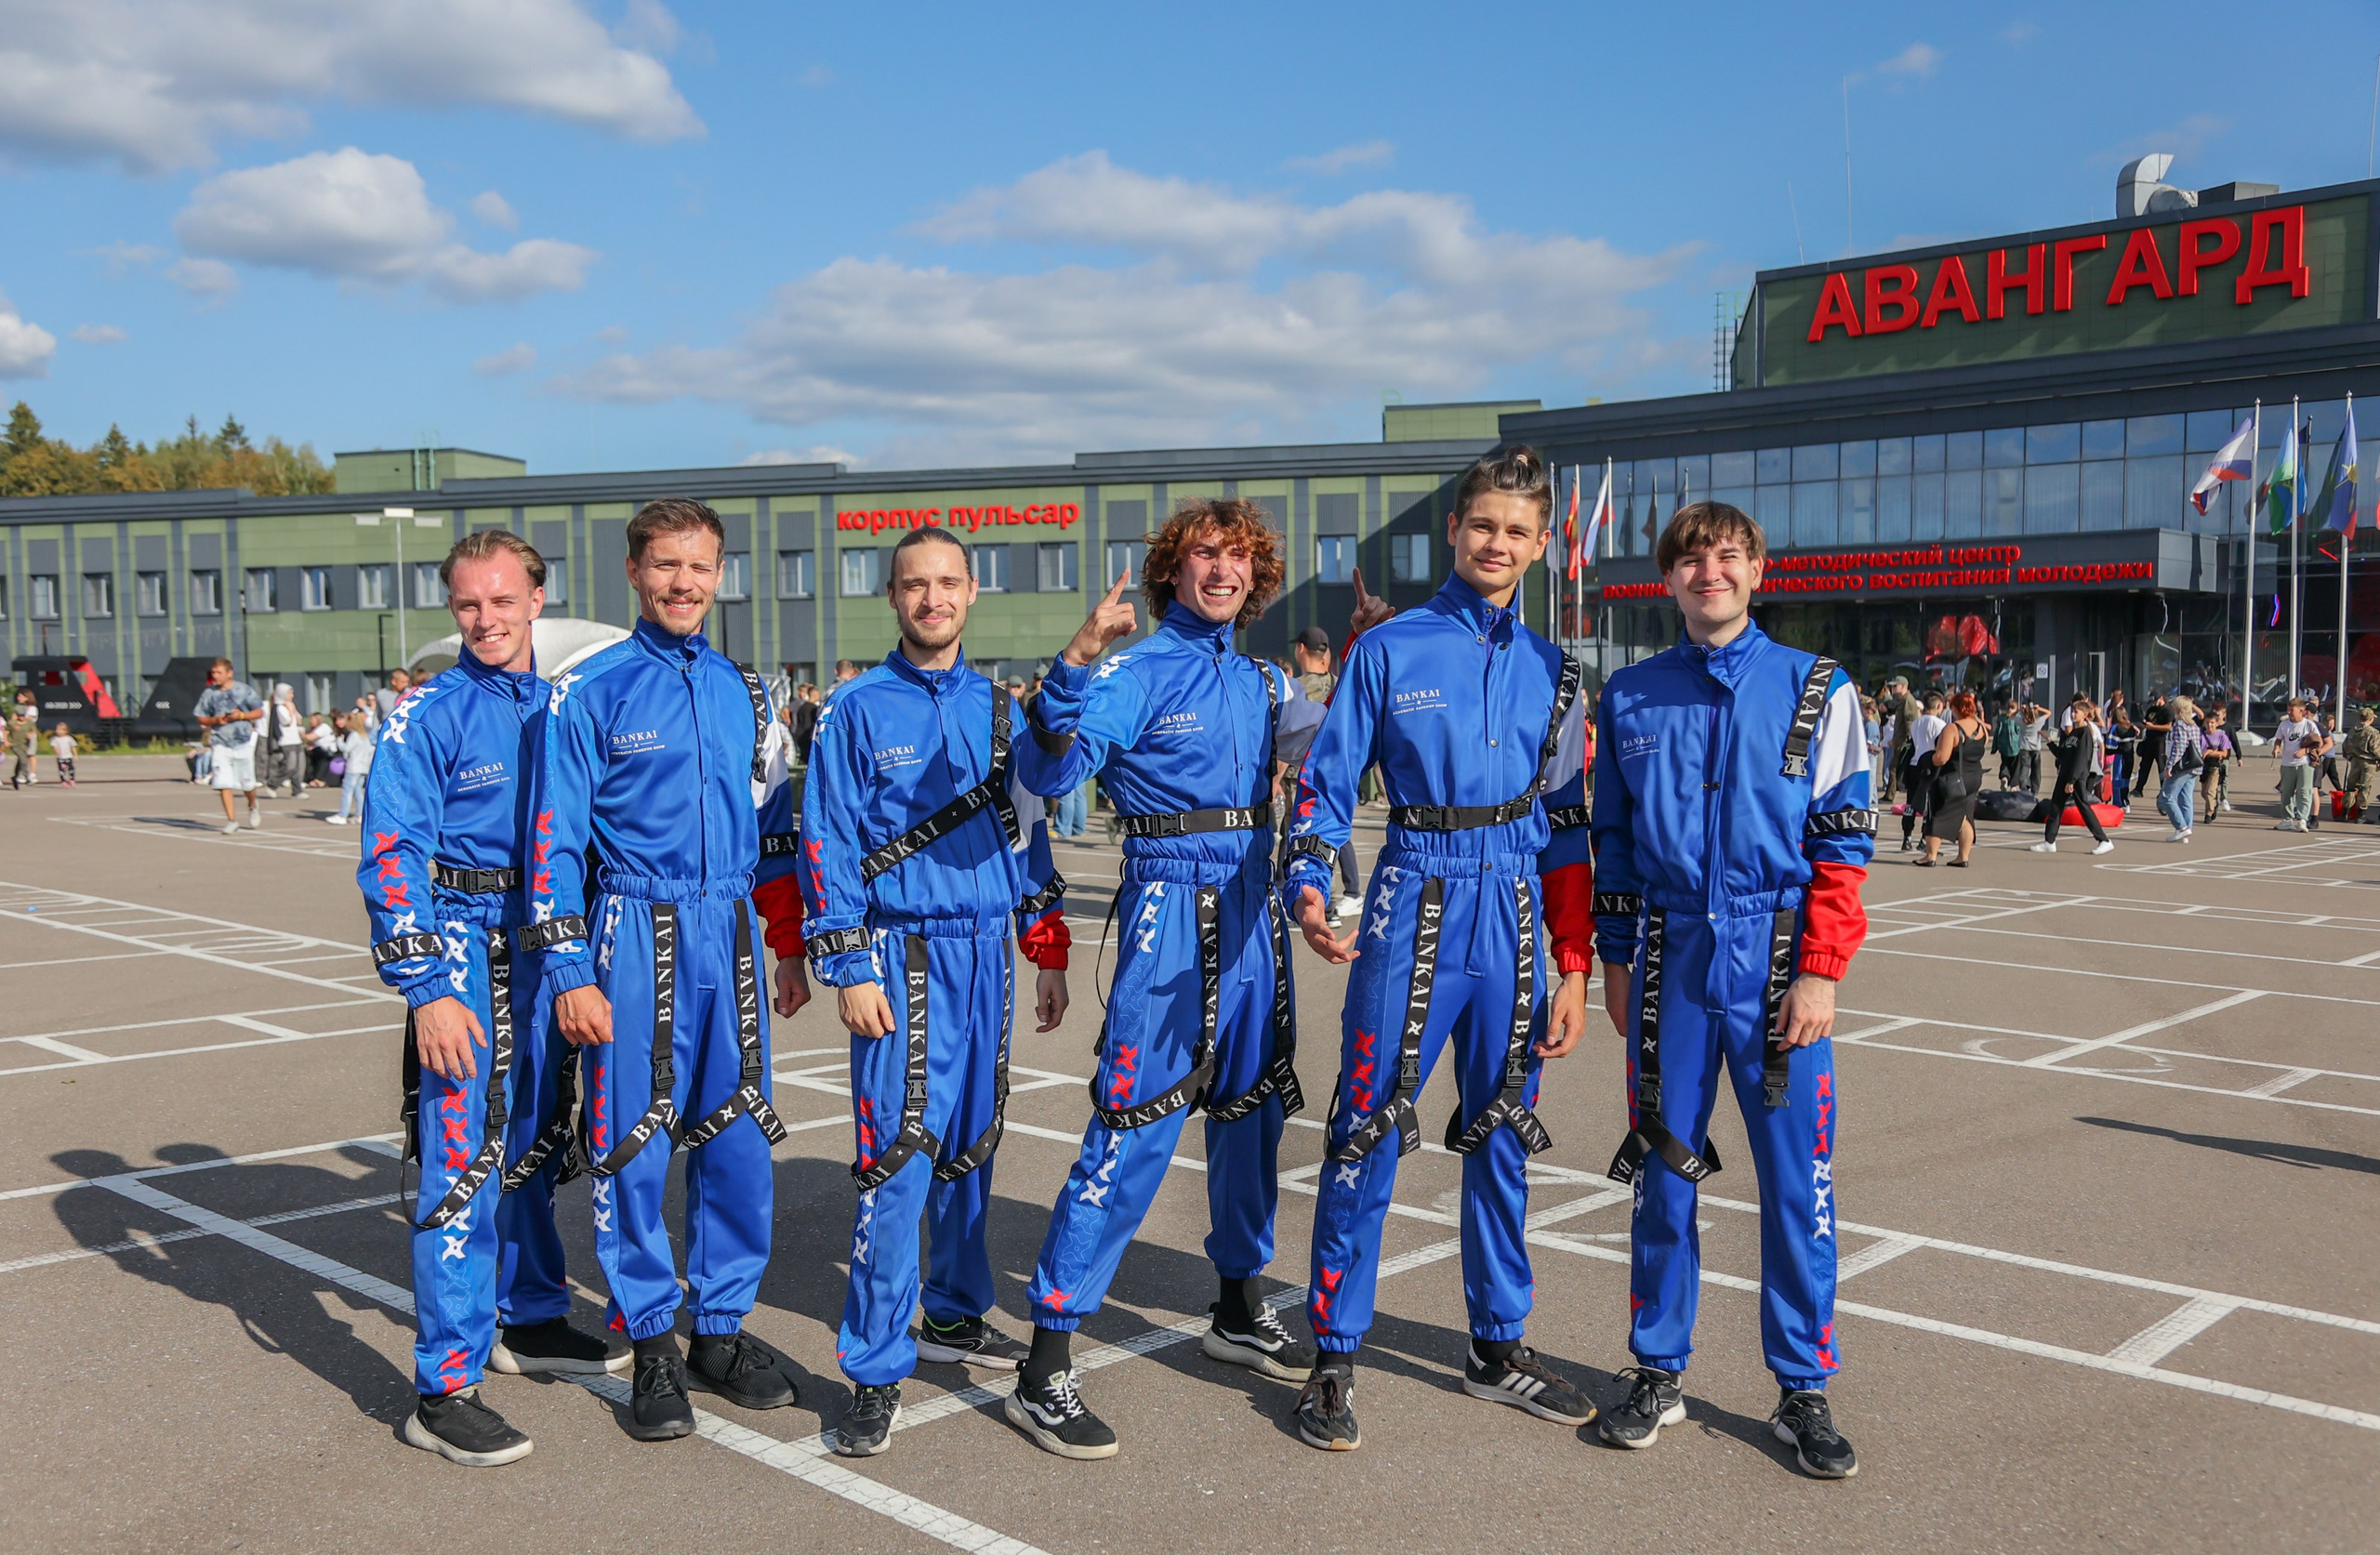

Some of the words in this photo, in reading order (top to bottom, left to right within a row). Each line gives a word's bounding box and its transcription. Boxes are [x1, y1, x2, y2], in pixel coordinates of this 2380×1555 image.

[1806, 204, 2309, 343] АВАНГАРД
[837, 507, 942, 535] корпус
[949, 502, 1080, 532] пульсар
[1949, 544, 2022, 567] центр
[1869, 567, 2011, 589] воспитания
[2016, 560, 2153, 585] молодежи
[1395, 689, 1440, 704] BANKAI
[1158, 712, 1197, 725] BANKAI
[612, 730, 657, 745] BANKAI
[874, 745, 915, 760] BANKAI
[1622, 734, 1657, 749] BANKAI
[459, 761, 504, 780] BANKAI
[1515, 876, 1533, 980] BANKAI
[655, 914, 674, 1023] BANKAI
[1409, 902, 1442, 1010] BANKAI
[1642, 915, 1662, 1024] BANKAI
[1201, 922, 1218, 1028] BANKAI
[492, 963, 512, 1073] BANKAI
[908, 970, 926, 1075] BANKAI
